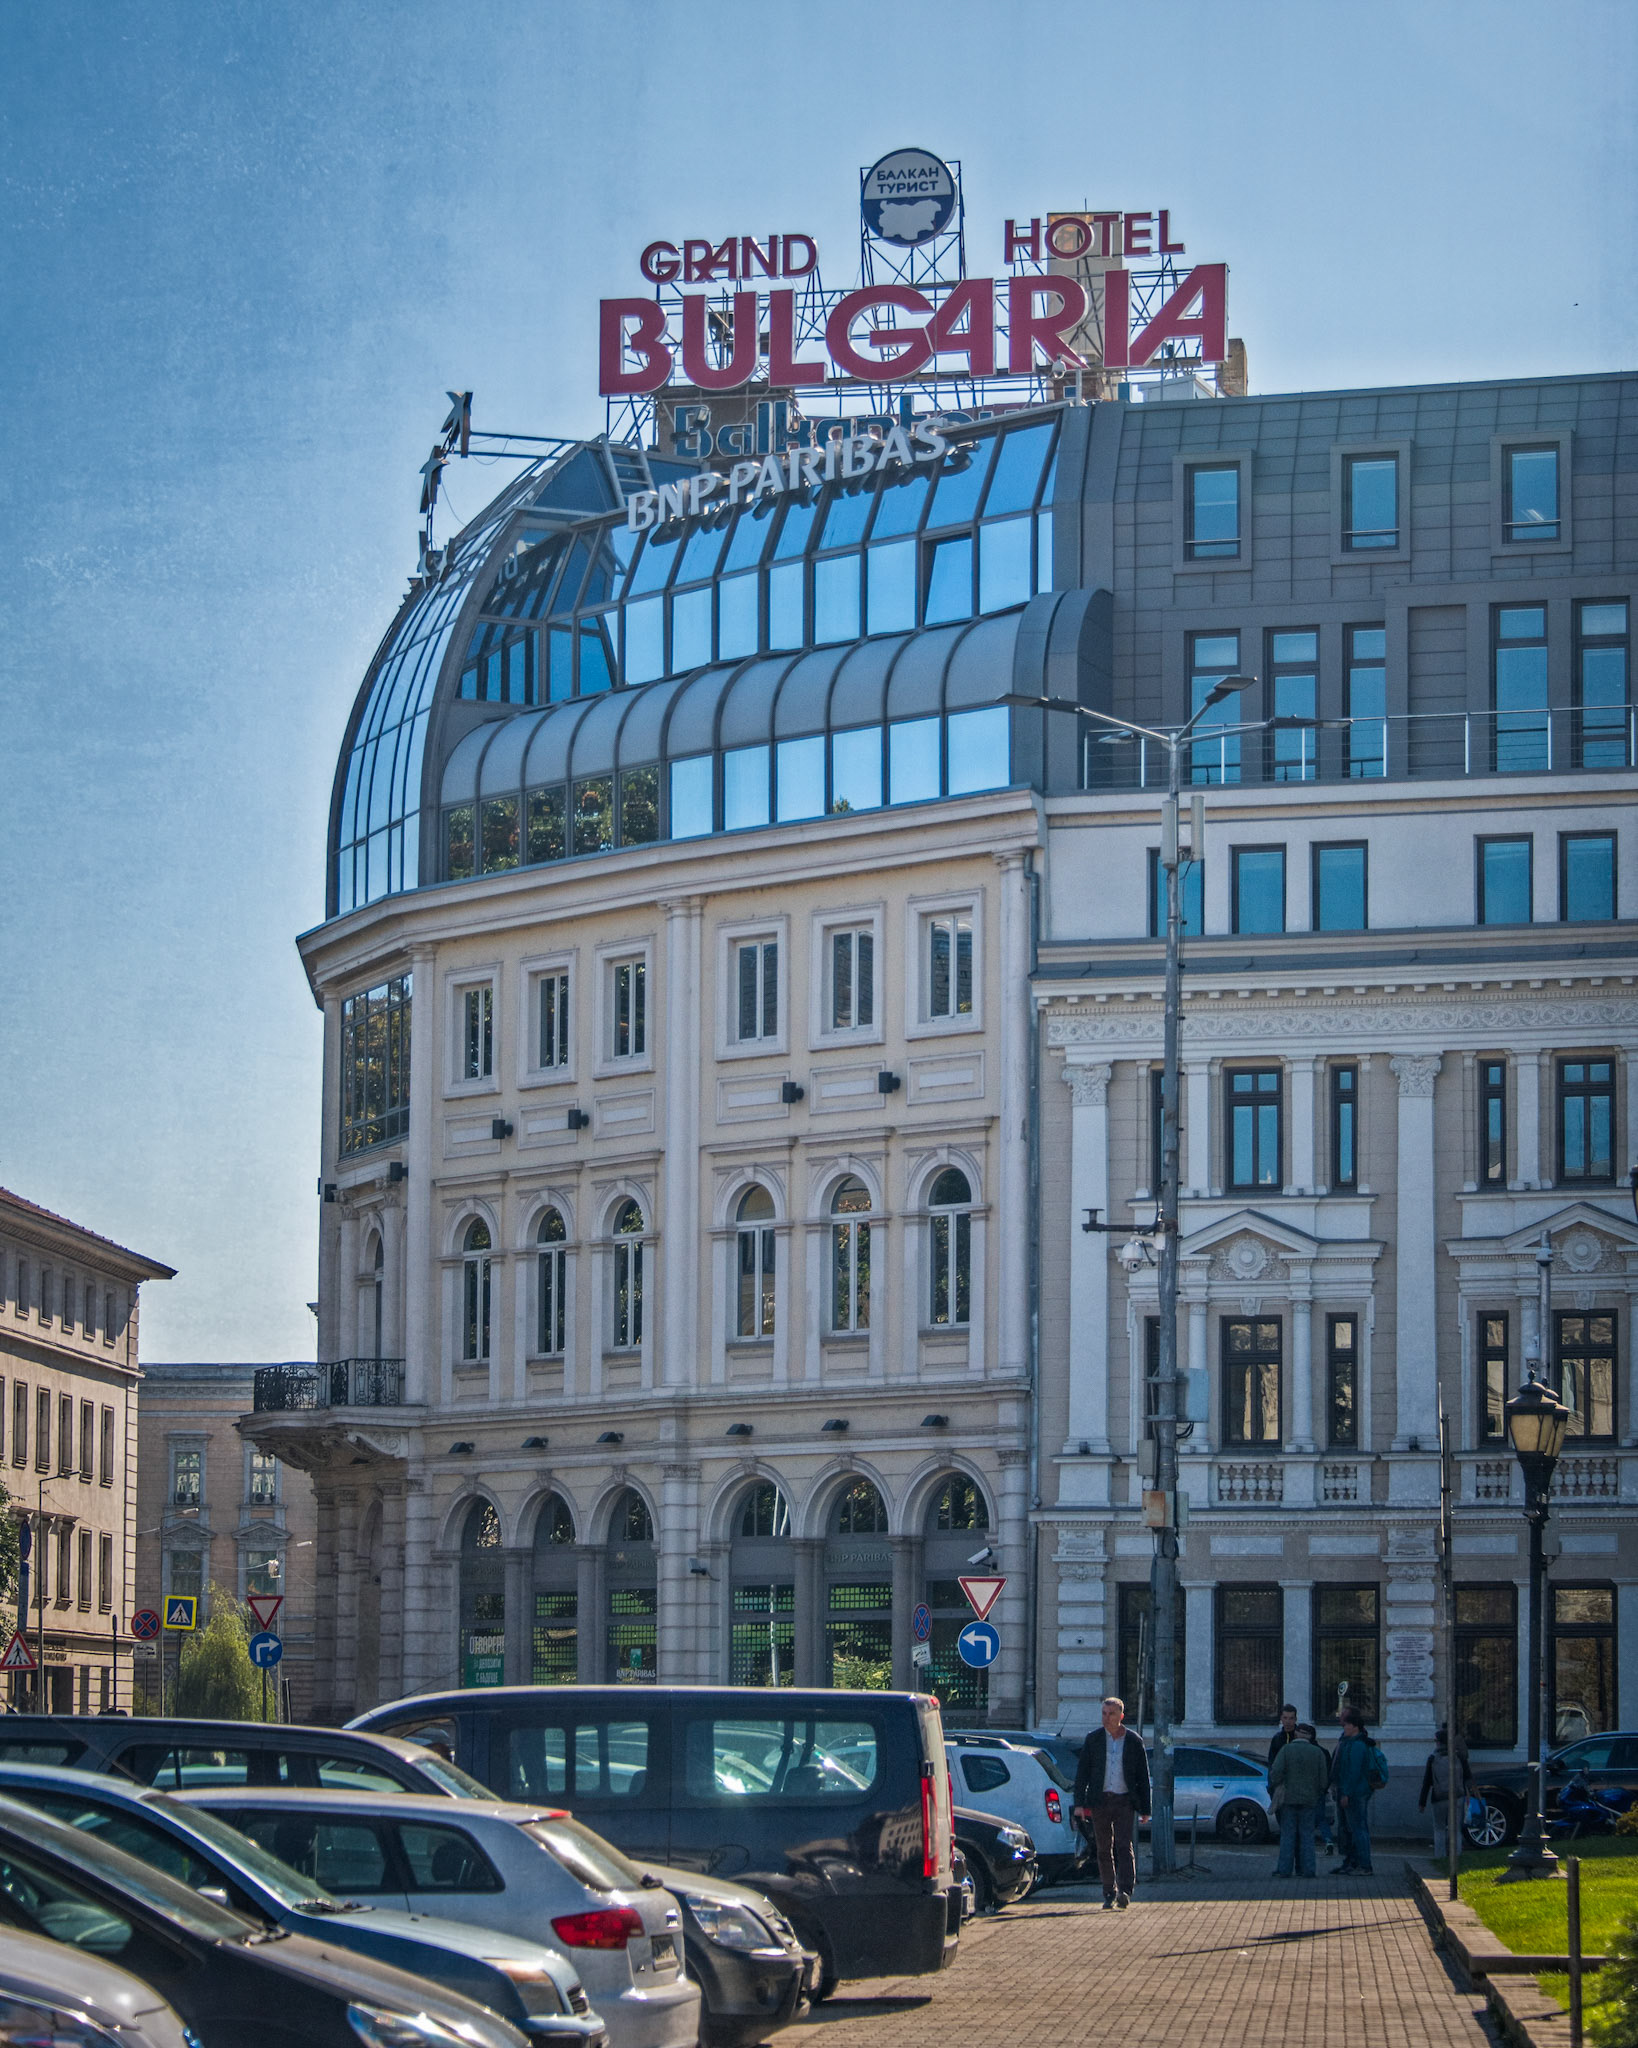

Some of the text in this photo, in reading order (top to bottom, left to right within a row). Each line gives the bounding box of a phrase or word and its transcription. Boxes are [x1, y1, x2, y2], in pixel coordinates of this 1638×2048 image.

[877, 167, 939, 181] БАЛКАН
[877, 181, 938, 194] ТУРИСТ
[640, 234, 819, 285] GRAND
[1004, 210, 1186, 265] HOTEL
[599, 263, 1228, 396] BULGARIA
[627, 417, 951, 533] BNP PARIBAS
